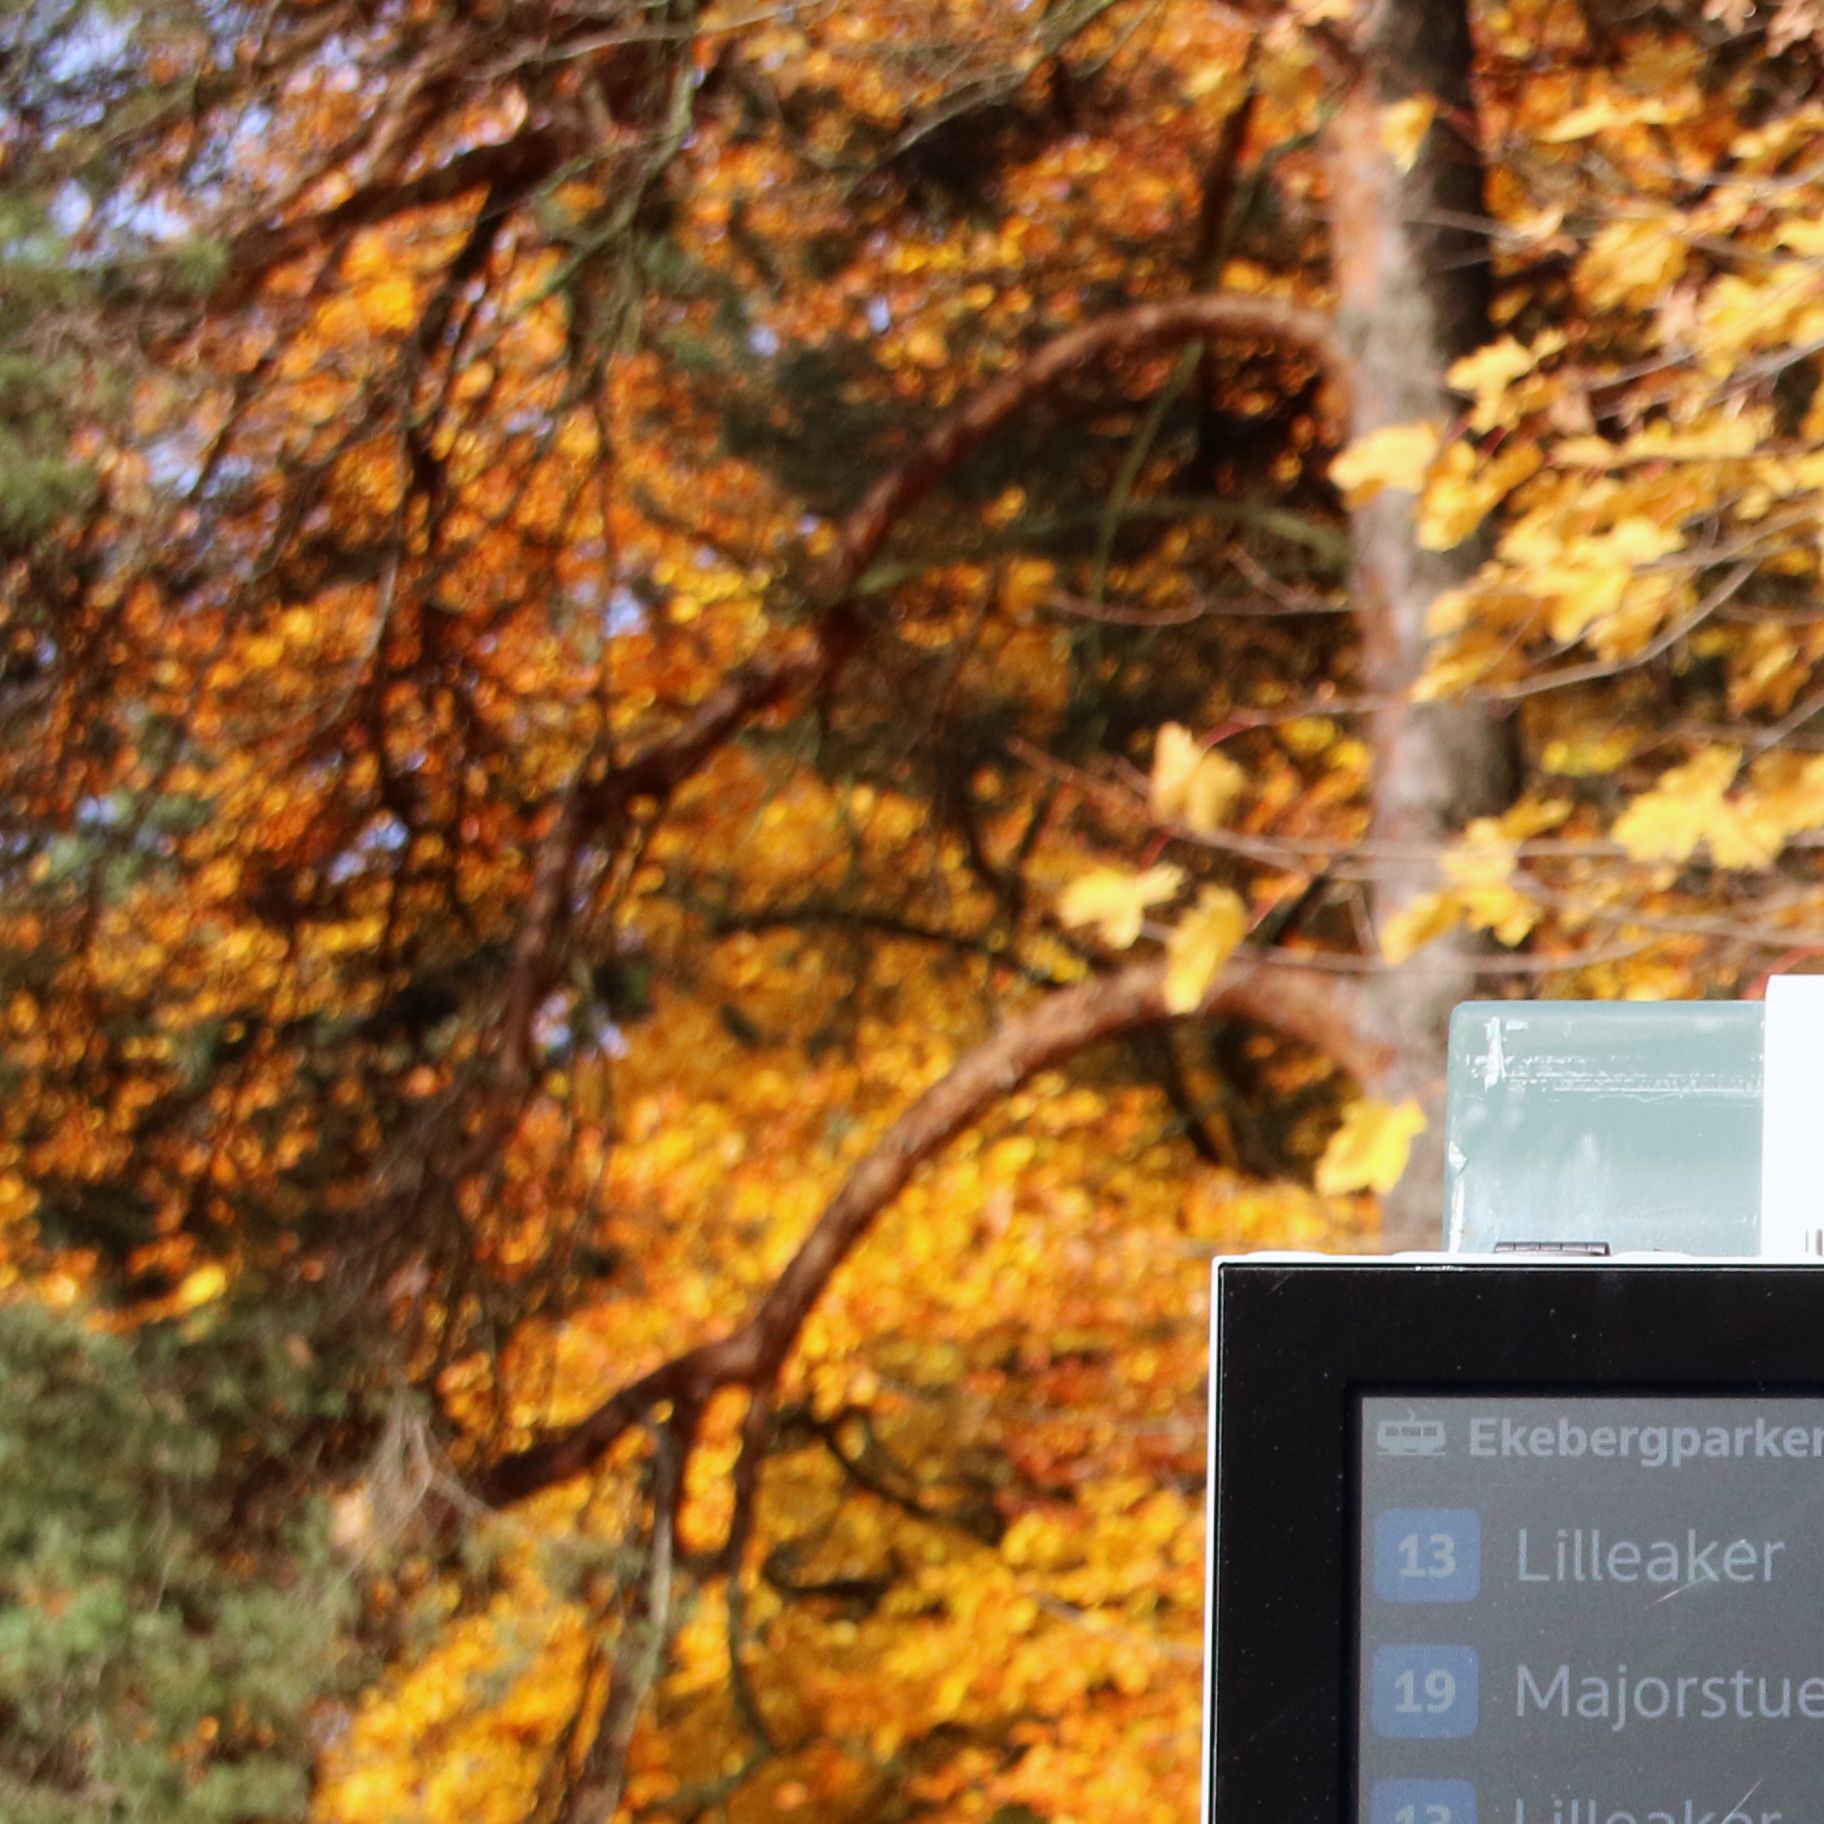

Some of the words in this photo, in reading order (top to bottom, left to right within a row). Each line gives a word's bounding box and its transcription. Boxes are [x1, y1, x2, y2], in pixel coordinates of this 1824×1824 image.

[1400, 1535, 1456, 1579] 13
[1516, 1528, 1785, 1583] Lilleaker
[1393, 1669, 1455, 1714] 19
